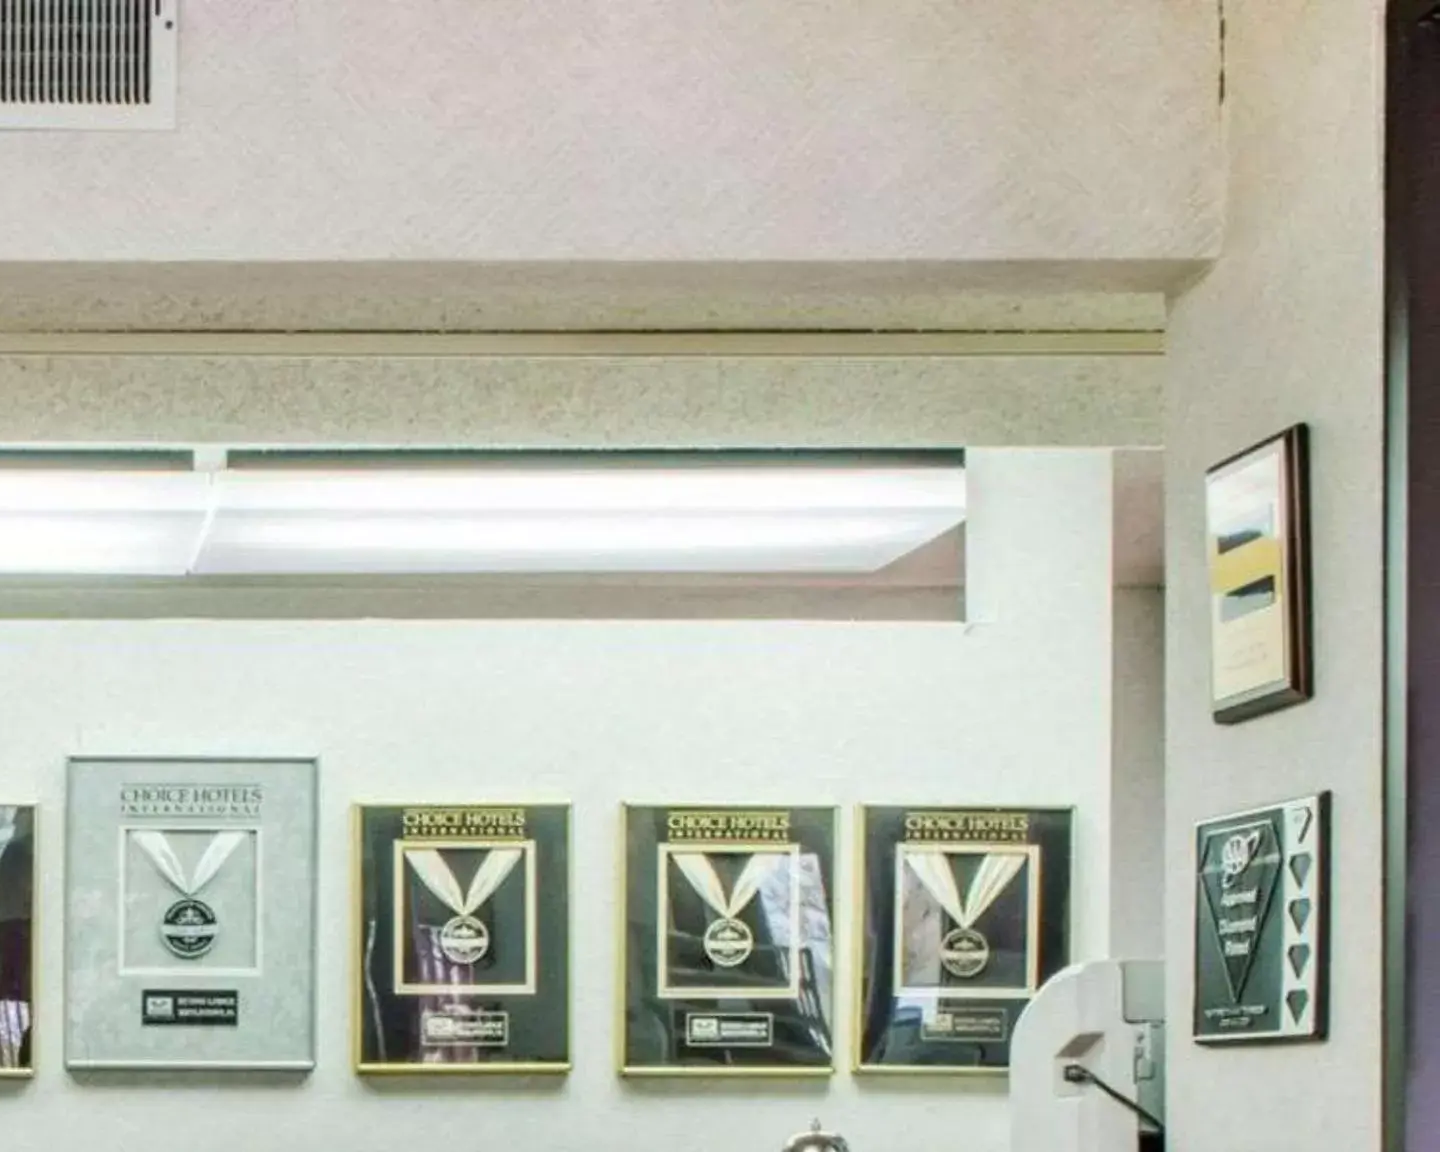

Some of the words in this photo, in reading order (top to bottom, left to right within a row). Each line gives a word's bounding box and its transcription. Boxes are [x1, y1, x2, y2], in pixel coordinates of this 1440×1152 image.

[120, 788, 188, 803] CHOICE
[194, 788, 263, 803] HOTELS
[402, 812, 463, 827] CHOICE
[465, 813, 525, 827] HOTELS
